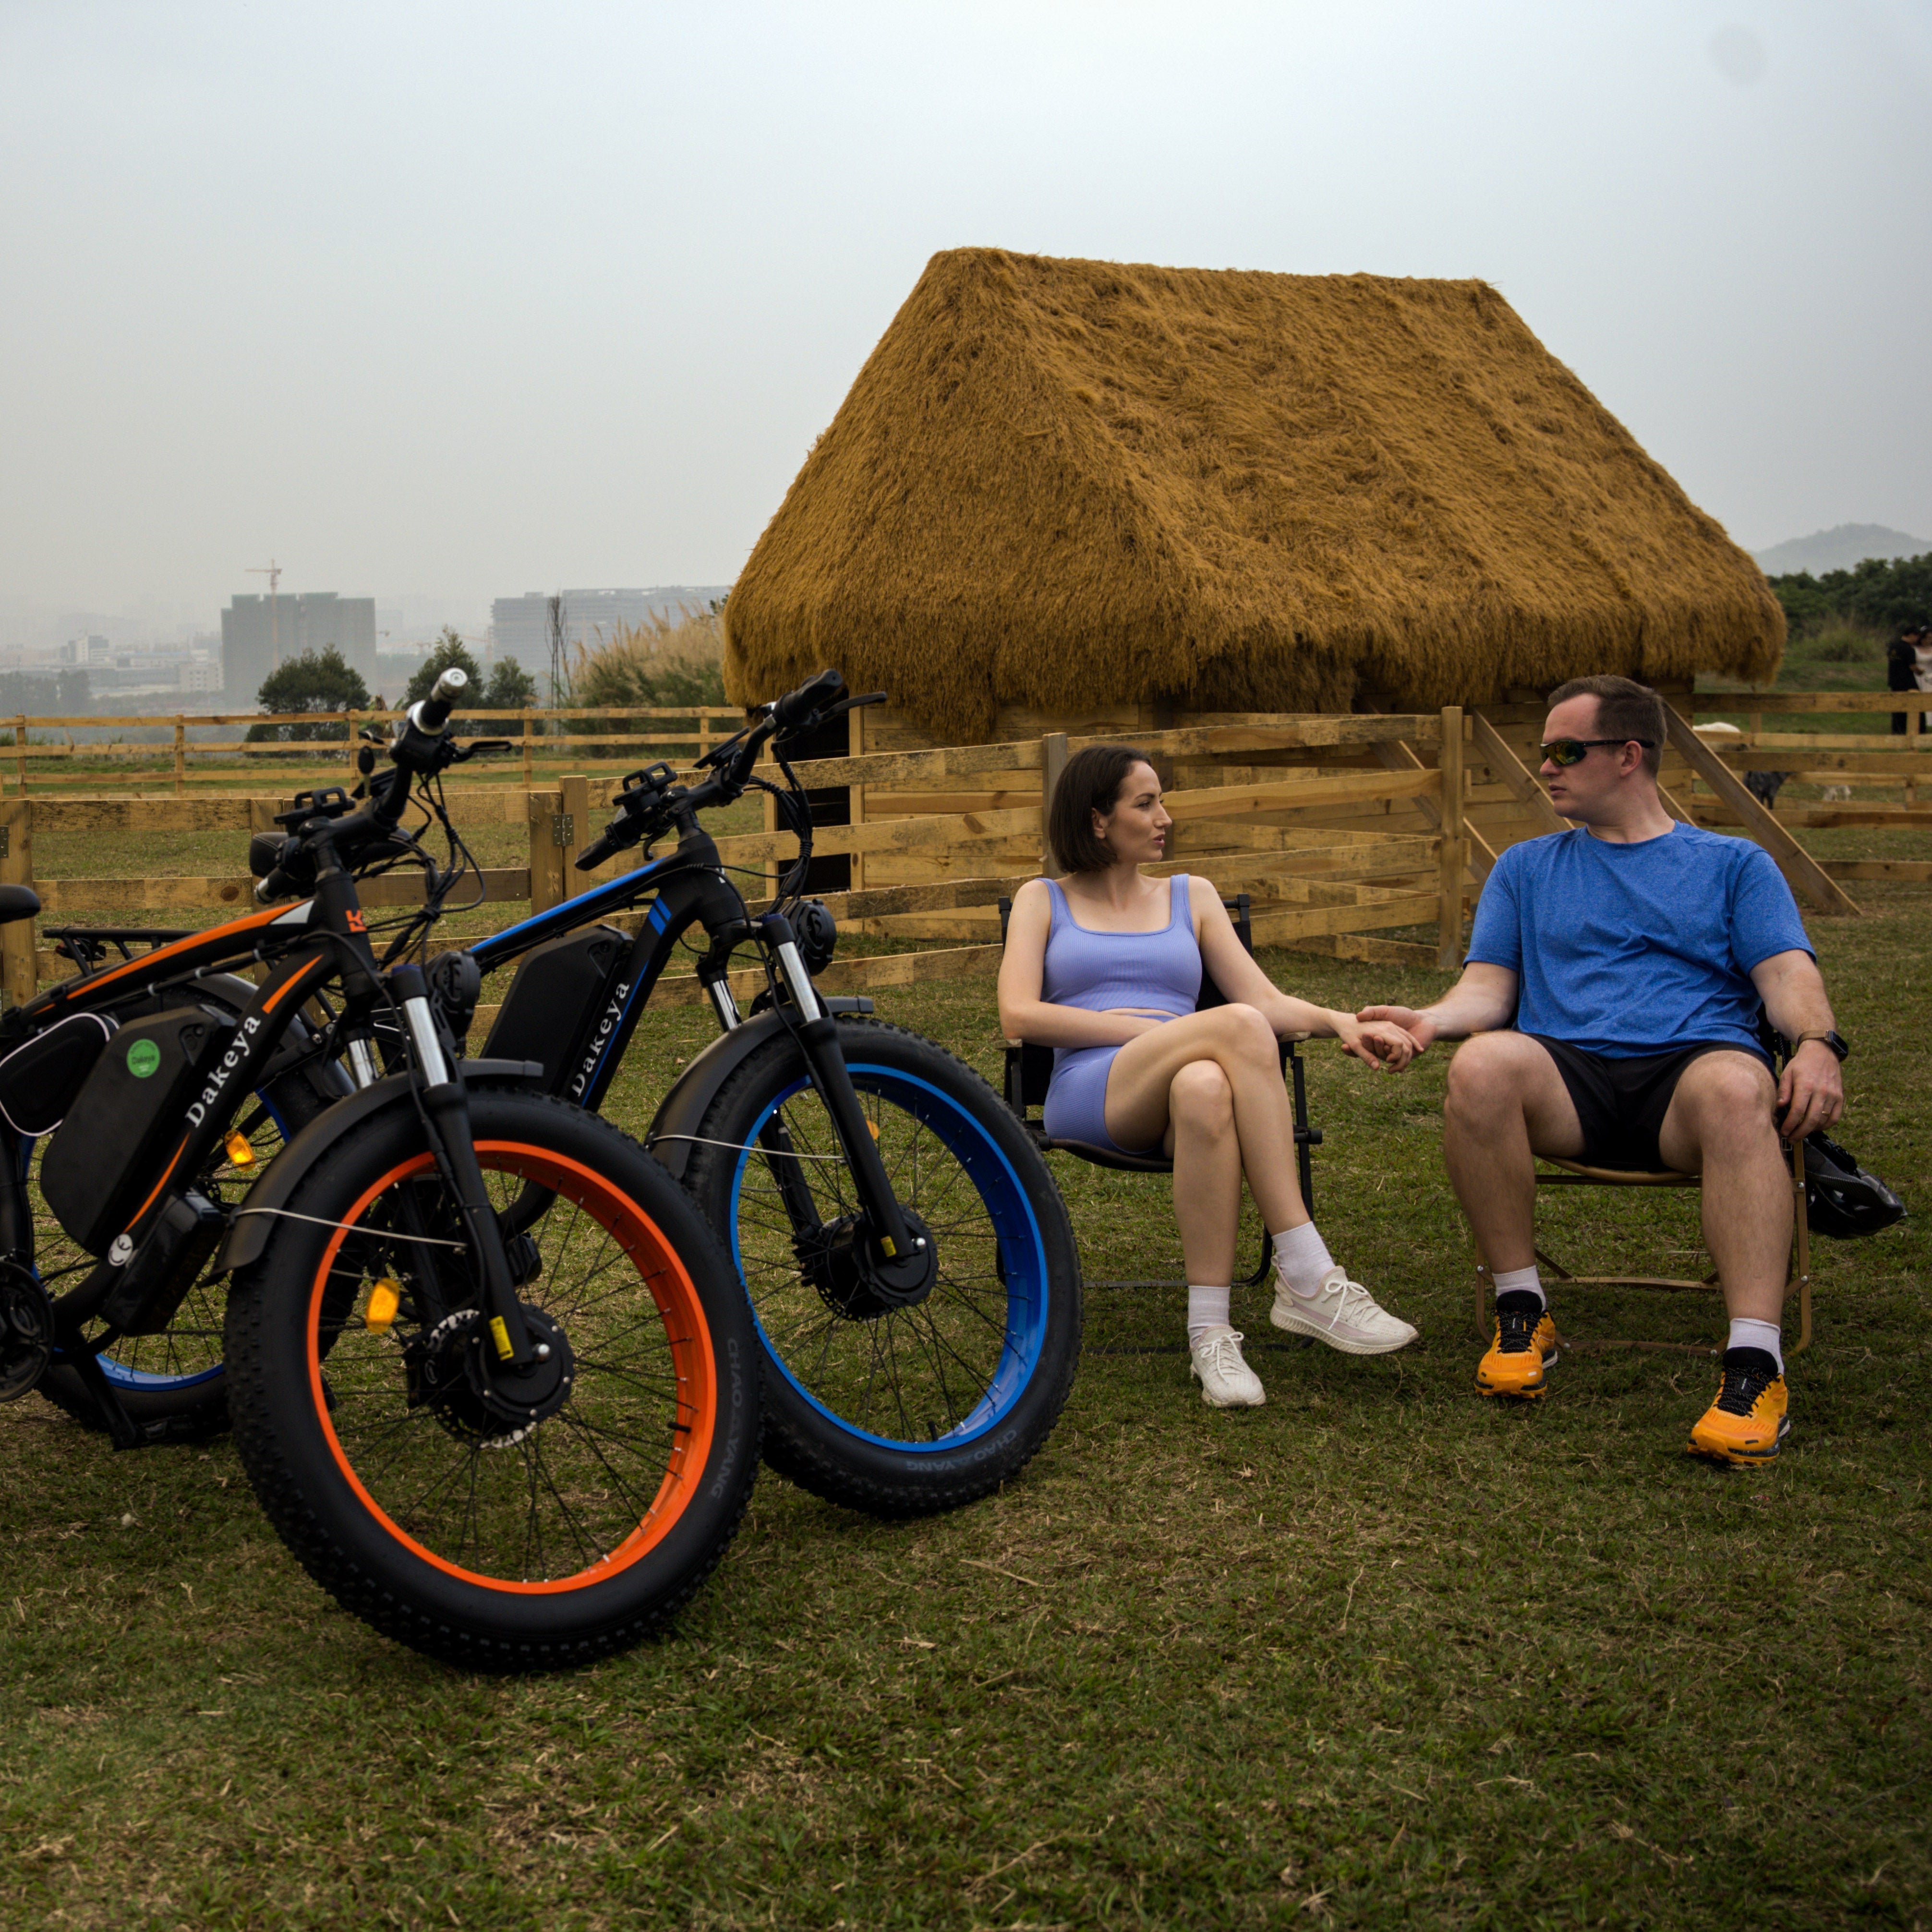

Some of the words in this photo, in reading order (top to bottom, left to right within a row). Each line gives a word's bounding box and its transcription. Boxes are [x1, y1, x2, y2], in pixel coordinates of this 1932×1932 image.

[185, 1016, 261, 1128] Dakeya
[571, 983, 629, 1097] Dakeya
[727, 1338, 742, 1408] CHAO
[711, 1437, 739, 1499] YANG
[906, 1460, 956, 1472] YANG
[974, 1429, 1017, 1461] CHAO
